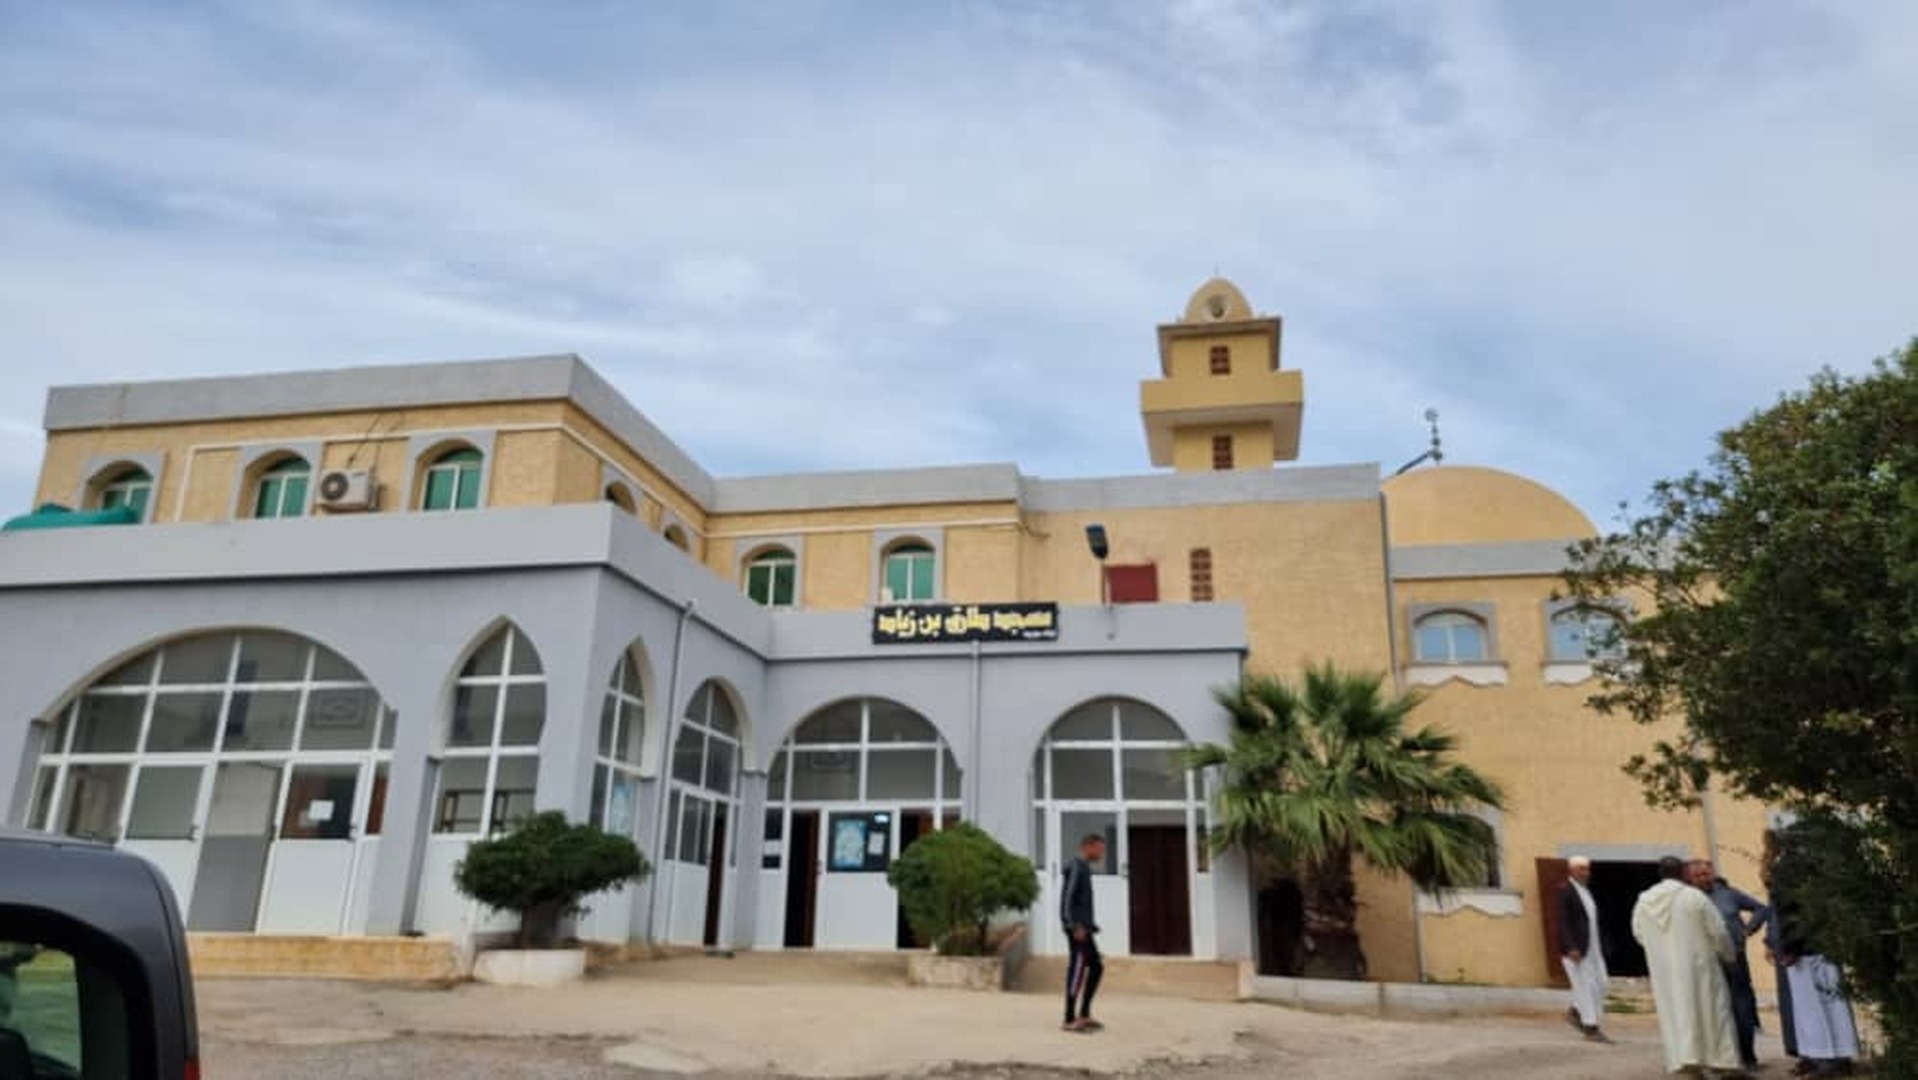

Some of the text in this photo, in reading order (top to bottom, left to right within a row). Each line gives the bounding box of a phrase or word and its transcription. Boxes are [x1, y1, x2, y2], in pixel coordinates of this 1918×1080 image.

[878, 606, 1053, 638] مسجد طارق بن زياد
